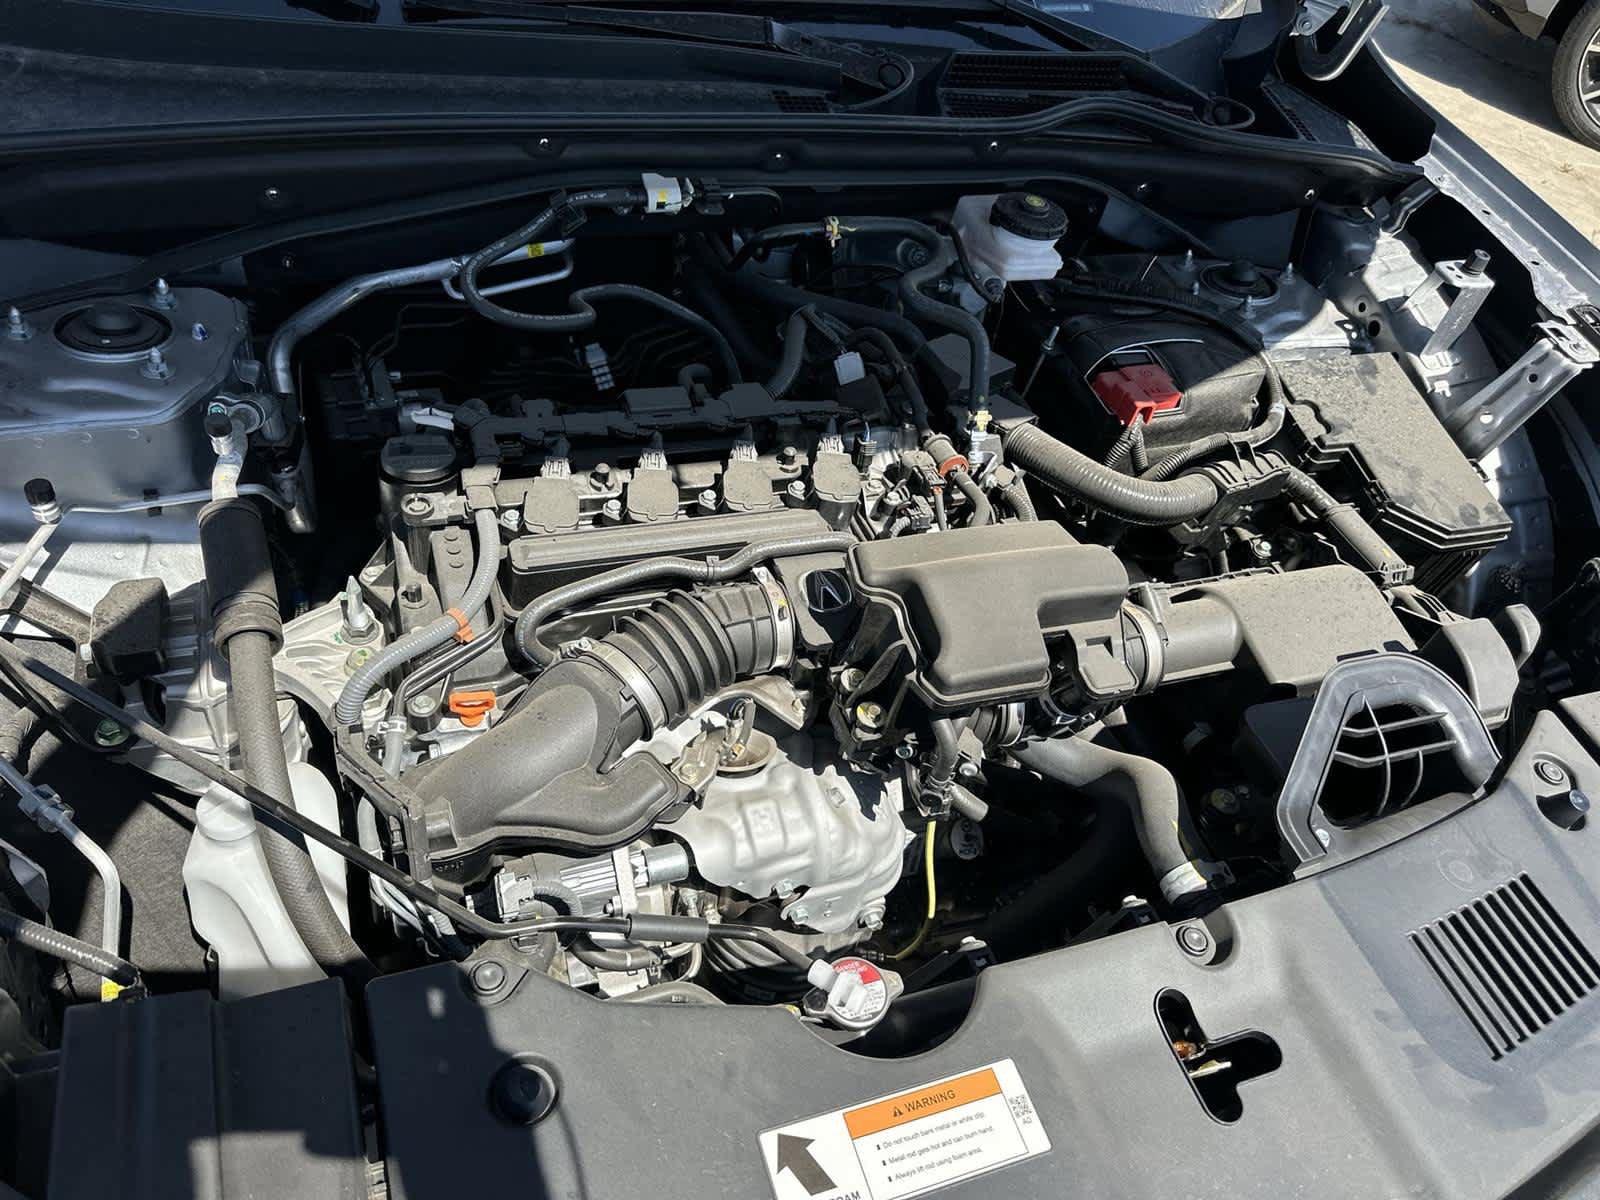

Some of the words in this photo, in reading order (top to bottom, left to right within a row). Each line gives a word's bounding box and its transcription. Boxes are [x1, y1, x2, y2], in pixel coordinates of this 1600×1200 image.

[905, 1090, 957, 1112] WARNING
[882, 1140, 892, 1149] Do
[893, 1137, 903, 1145] not
[903, 1131, 921, 1142] touch
[921, 1127, 935, 1136] bare
[935, 1122, 951, 1132] metal
[958, 1114, 974, 1124] white
[888, 1154, 905, 1164] Metal
[906, 1150, 917, 1158] rod
[917, 1146, 930, 1156] gets
[930, 1142, 941, 1151] hot
[941, 1138, 953, 1147] and
[953, 1134, 964, 1143] can
[964, 1130, 978, 1140] burn
[895, 1168, 916, 1180] Always
[916, 1165, 924, 1173] lift
[924, 1161, 935, 1170] rod
[935, 1156, 953, 1167] using
[952, 1151, 968, 1161] foam
[829, 1190, 861, 1200] AM
